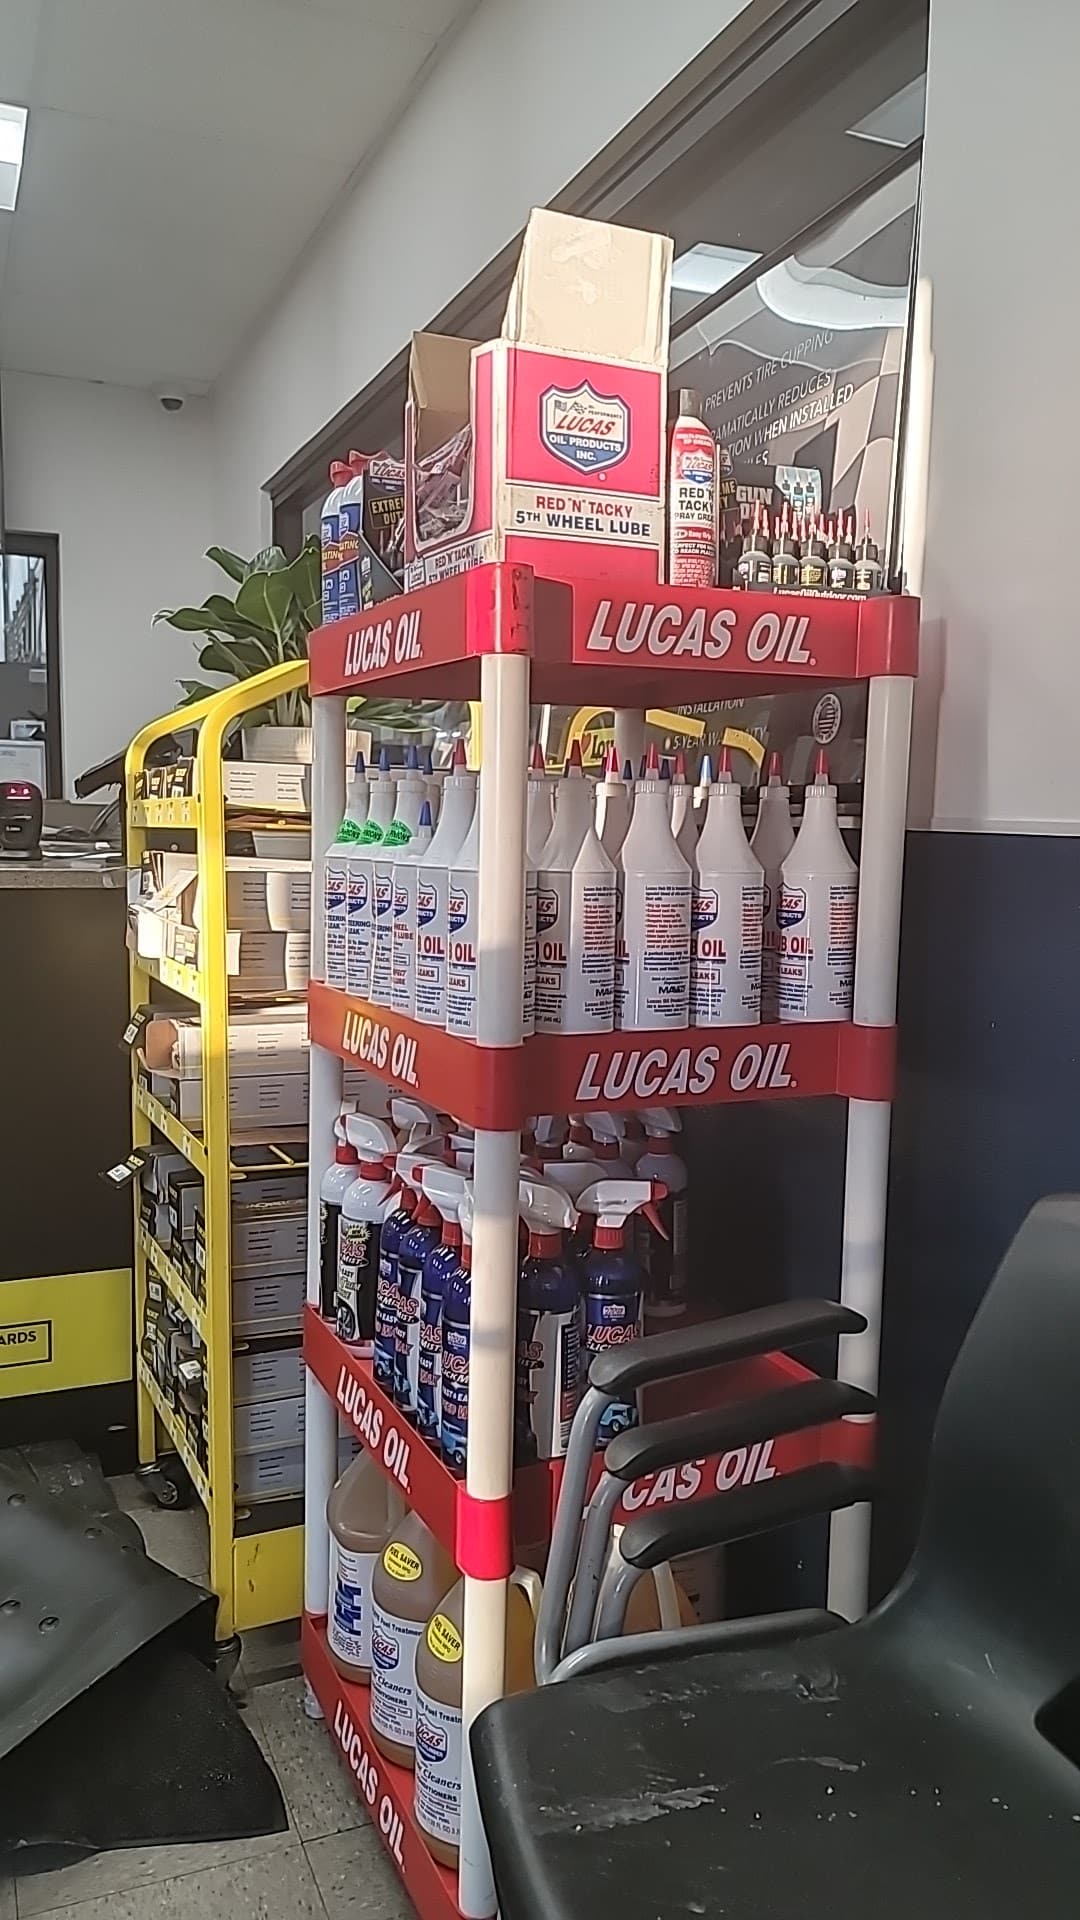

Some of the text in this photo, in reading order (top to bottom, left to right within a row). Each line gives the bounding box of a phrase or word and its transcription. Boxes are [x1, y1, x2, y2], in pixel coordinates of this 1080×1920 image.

[705, 372, 753, 413] PREVENTS
[756, 356, 777, 384] TIRE
[711, 368, 831, 441] RAMATICALLY REDUCES
[754, 419, 788, 447] WHEN
[789, 383, 854, 429] INSTALLED
[555, 414, 616, 436] LUCAS
[549, 434, 622, 453] OIL PRODUCTS
[576, 450, 597, 461] INC.
[679, 487, 704, 499] RED
[737, 486, 773, 504] GUN
[371, 497, 404, 515] EXTRE
[536, 496, 566, 511] RED
[588, 502, 633, 518] TACKY
[516, 511, 650, 537] 5TH WHEEL LUBE
[435, 556, 446, 569] RED
[454, 543, 475, 561] TACKY
[587, 600, 811, 664] LUCAS OIL
[344, 610, 422, 677] LUCAS OIL
[424, 935, 445, 955] OIL
[455, 942, 476, 963] OIL
[543, 941, 567, 961] OIL
[702, 939, 726, 957] OIL
[790, 935, 814, 955] OIL
[780, 966, 802, 977] LEAKS
[342, 1011, 389, 1069] LUCAS
[391, 1034, 417, 1087] OIL
[575, 1043, 791, 1101] LUCAS OIL
[336, 1365, 410, 1487] LUCAS OIL
[621, 1438, 777, 1512] CAS OIL
[400, 1553, 420, 1571] SAVER
[441, 1629, 461, 1651] SAVER
[378, 1676, 412, 1695] Cleaners
[425, 1705, 438, 1717] Fuel
[333, 1700, 379, 1801] LUCAS
[378, 1797, 405, 1867] OIL
[423, 1769, 462, 1791] Cleaners
